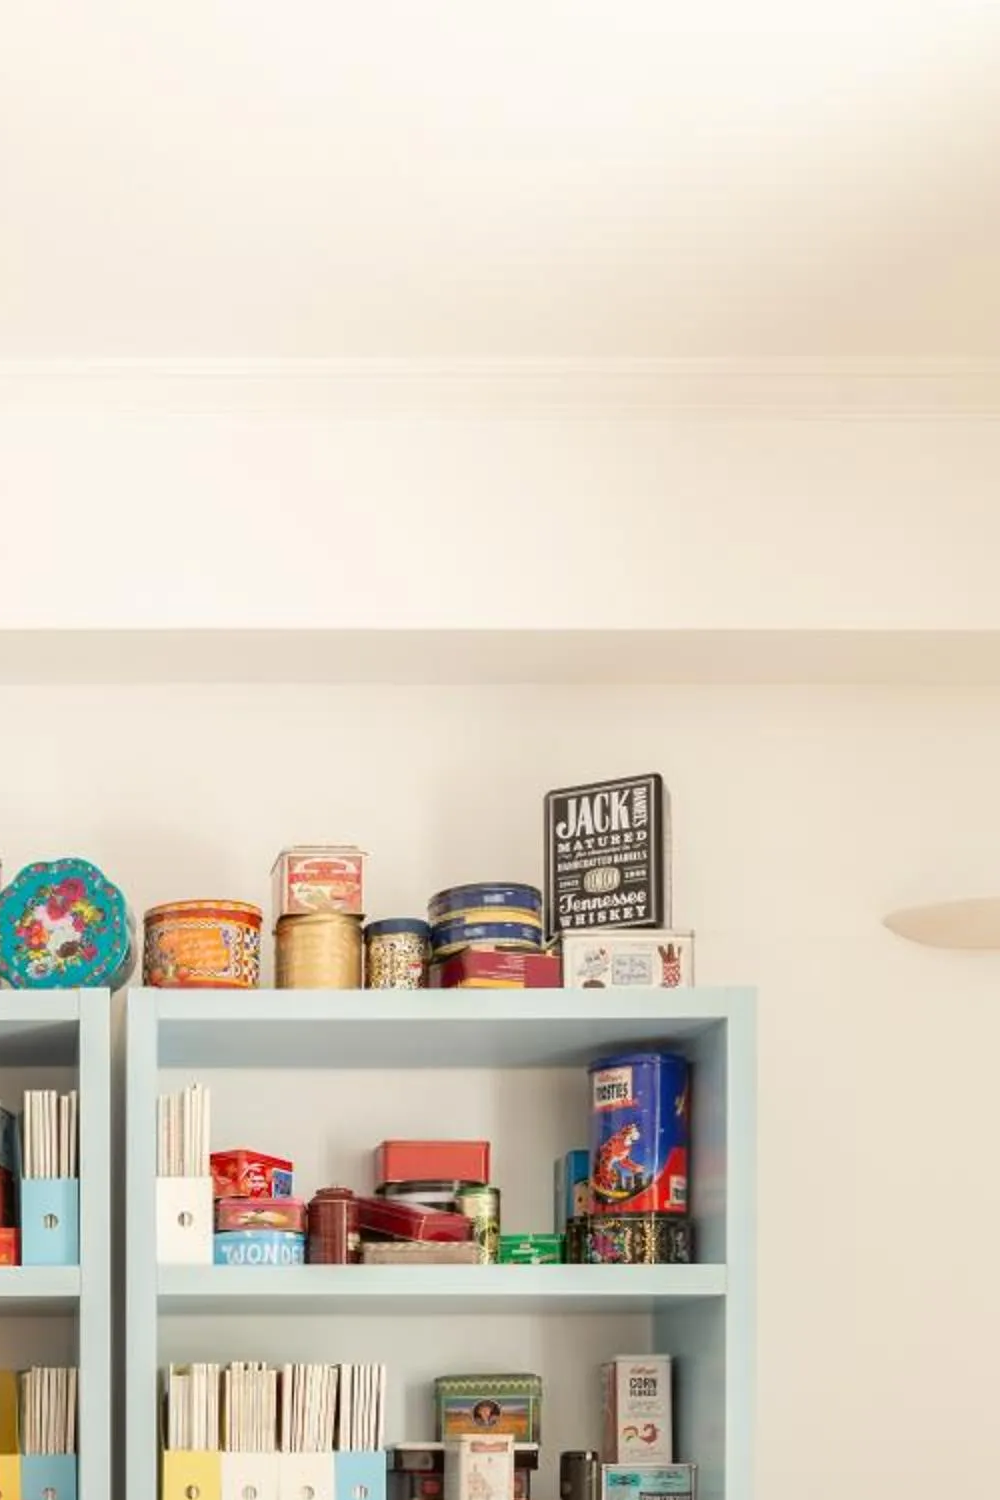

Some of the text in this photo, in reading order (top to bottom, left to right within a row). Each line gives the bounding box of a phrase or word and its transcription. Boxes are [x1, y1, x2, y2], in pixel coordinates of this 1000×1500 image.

[556, 789, 630, 839] JACK
[558, 831, 647, 853] MATURED
[559, 891, 647, 914] Tennessee
[559, 905, 646, 928] WHISKEY
[629, 1377, 658, 1389] CORN
